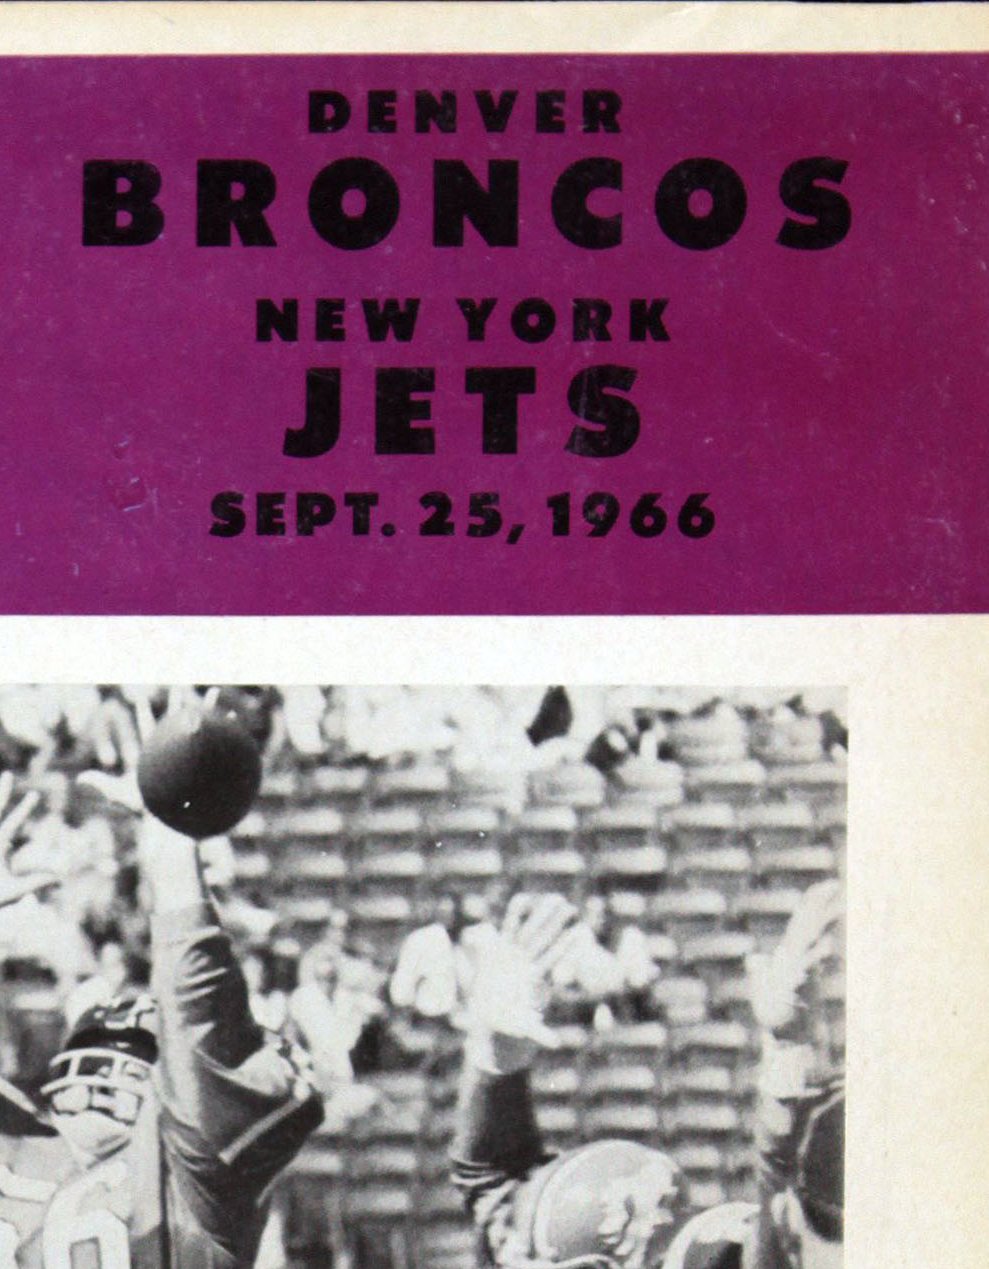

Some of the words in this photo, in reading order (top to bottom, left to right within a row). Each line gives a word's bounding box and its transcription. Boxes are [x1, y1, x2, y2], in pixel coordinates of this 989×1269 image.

[309, 90, 621, 133] DENVER
[82, 157, 851, 250] BRONCOS
[257, 299, 419, 342] NEW
[458, 298, 669, 343] YORK
[283, 364, 640, 458] JETS
[210, 492, 395, 537] SEPT.
[420, 492, 523, 544] 25,
[547, 493, 714, 538] 1966
